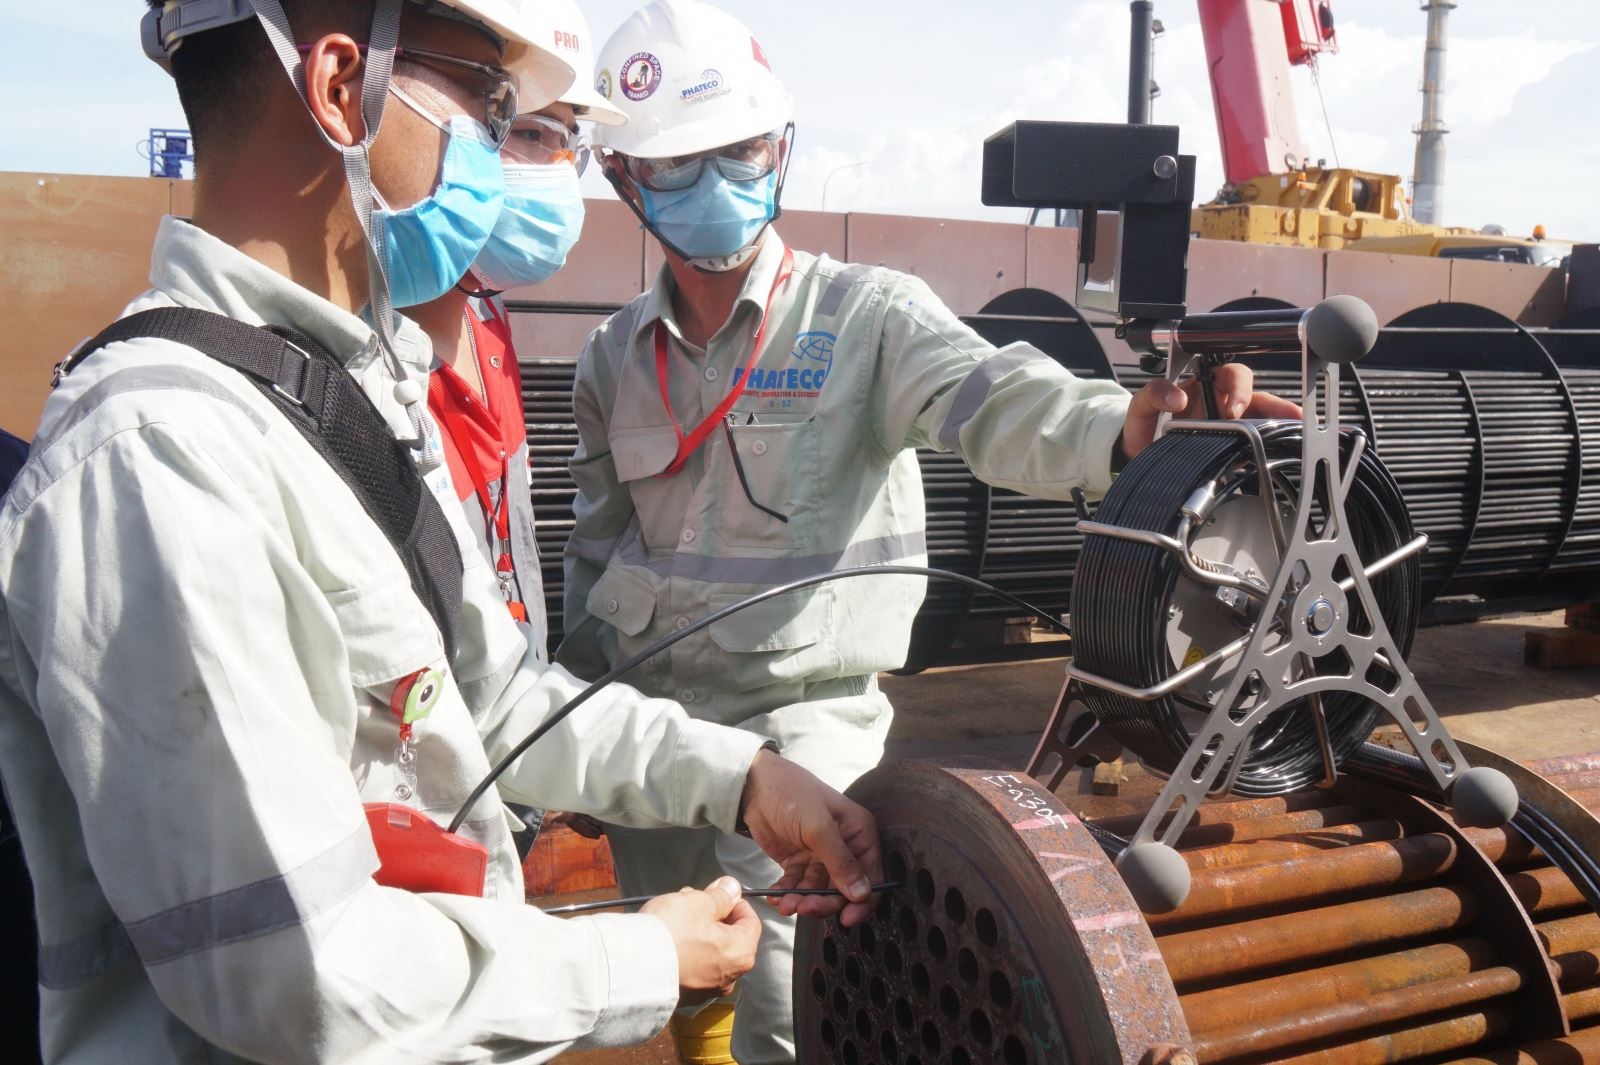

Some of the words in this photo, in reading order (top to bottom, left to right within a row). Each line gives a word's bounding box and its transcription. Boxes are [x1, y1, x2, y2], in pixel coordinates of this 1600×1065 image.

[621, 52, 649, 80] CONFINED
[649, 56, 661, 80] SPACE
[681, 80, 718, 97] PHATECO
